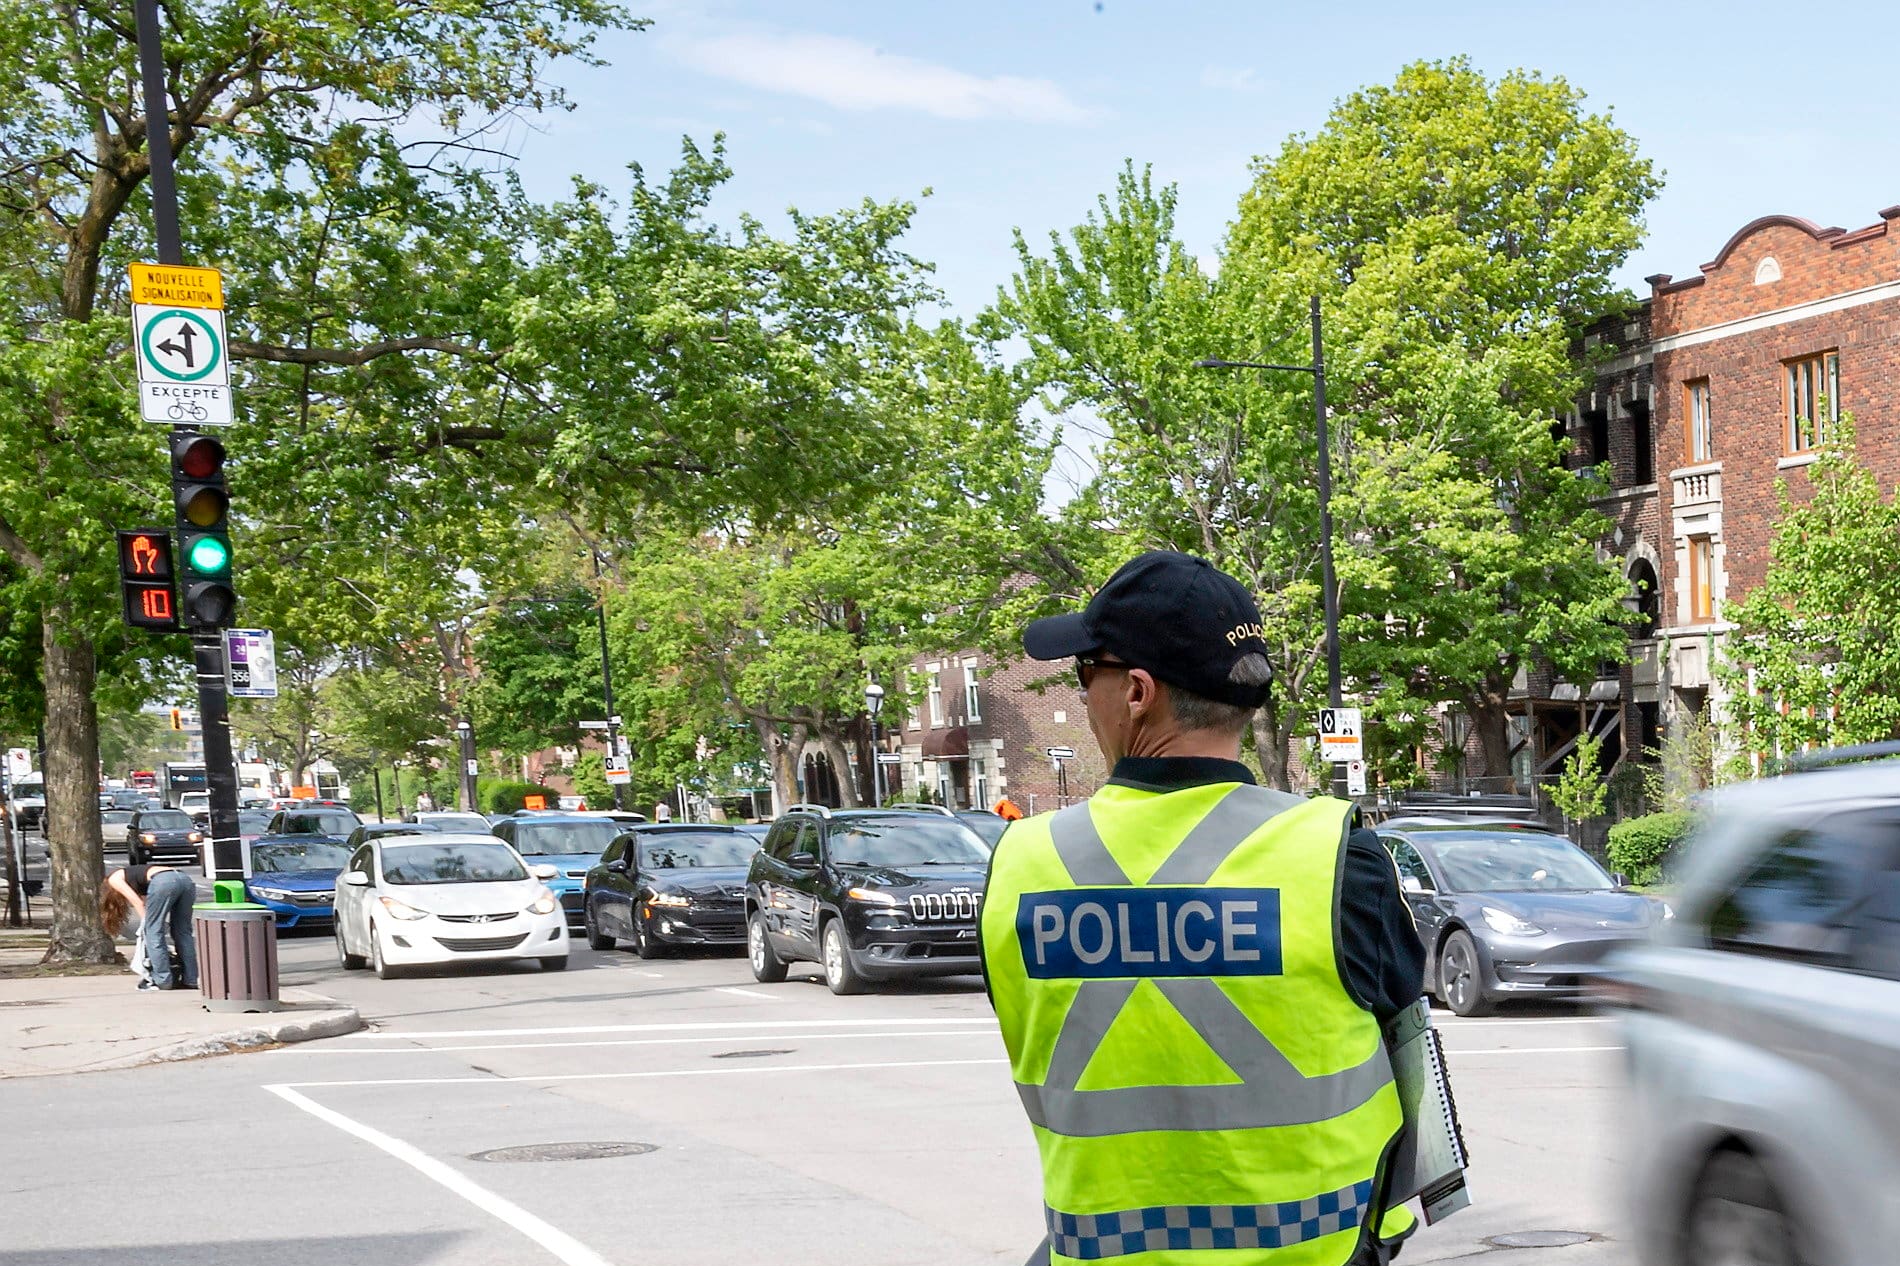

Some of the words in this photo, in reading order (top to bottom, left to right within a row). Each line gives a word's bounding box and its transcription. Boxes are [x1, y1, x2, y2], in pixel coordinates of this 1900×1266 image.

[147, 272, 205, 288] NOUVELLE
[142, 286, 213, 303] SIGNALISATION
[152, 386, 220, 399] EXCEPTÉ
[143, 590, 171, 618] 10
[232, 671, 250, 682] 356
[1033, 900, 1261, 965] POLICE
